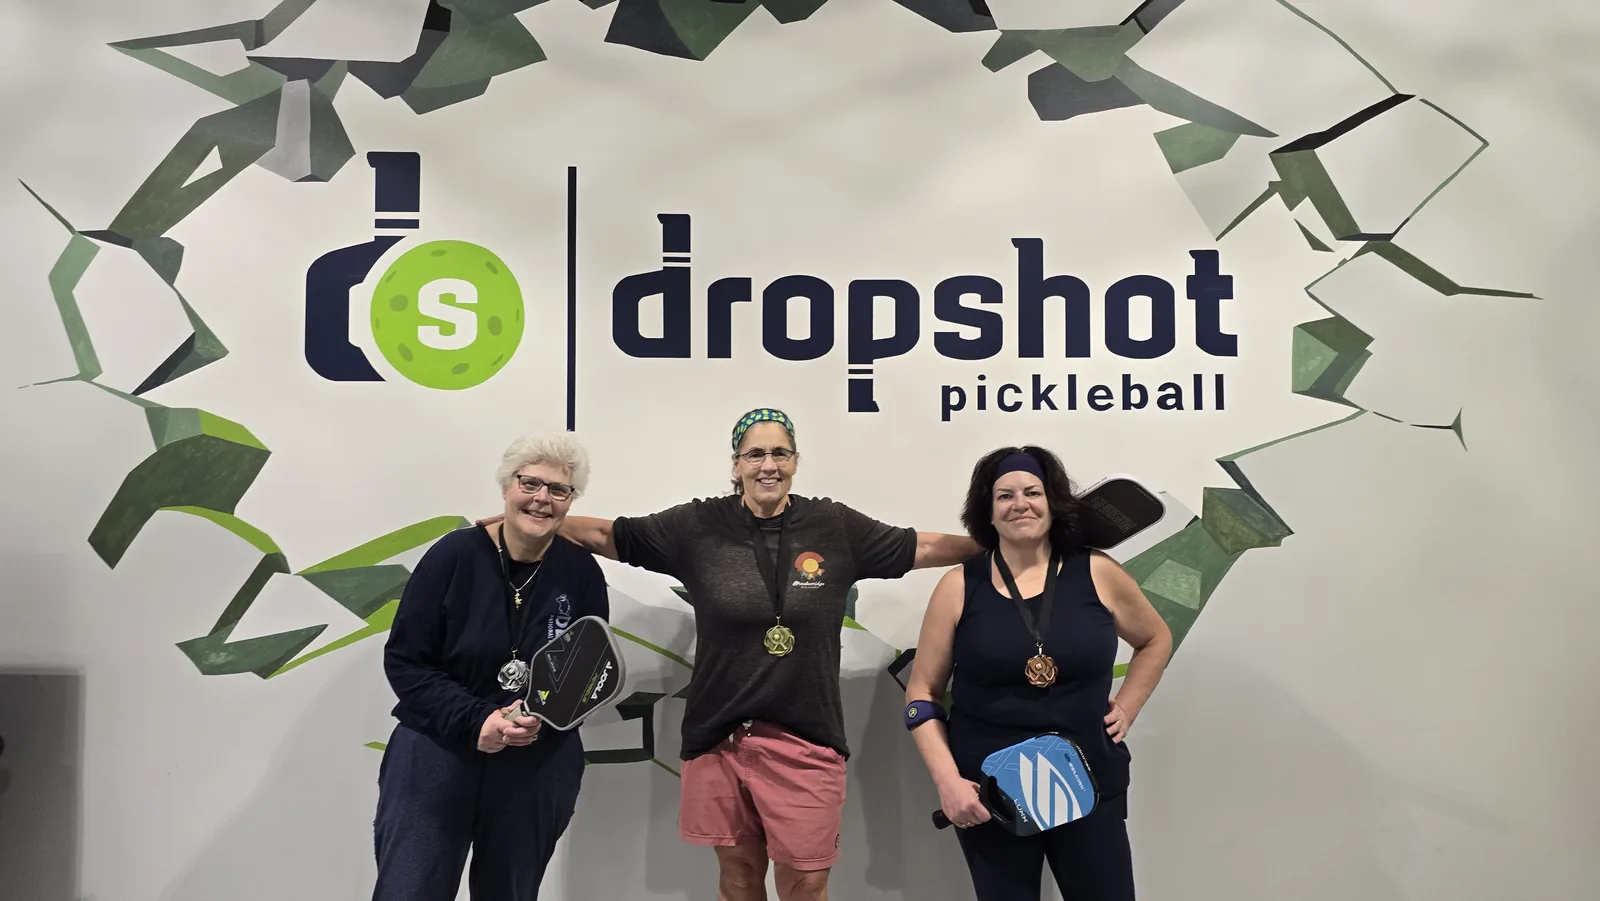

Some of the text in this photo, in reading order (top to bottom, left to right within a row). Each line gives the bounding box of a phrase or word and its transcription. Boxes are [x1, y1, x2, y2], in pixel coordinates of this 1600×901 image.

[612, 213, 1238, 413] dropshot
[941, 374, 1226, 422] pickleball
[591, 669, 609, 700] JOOLA
[1068, 762, 1085, 790] SELKIRK
[1013, 798, 1029, 823] LUXX
